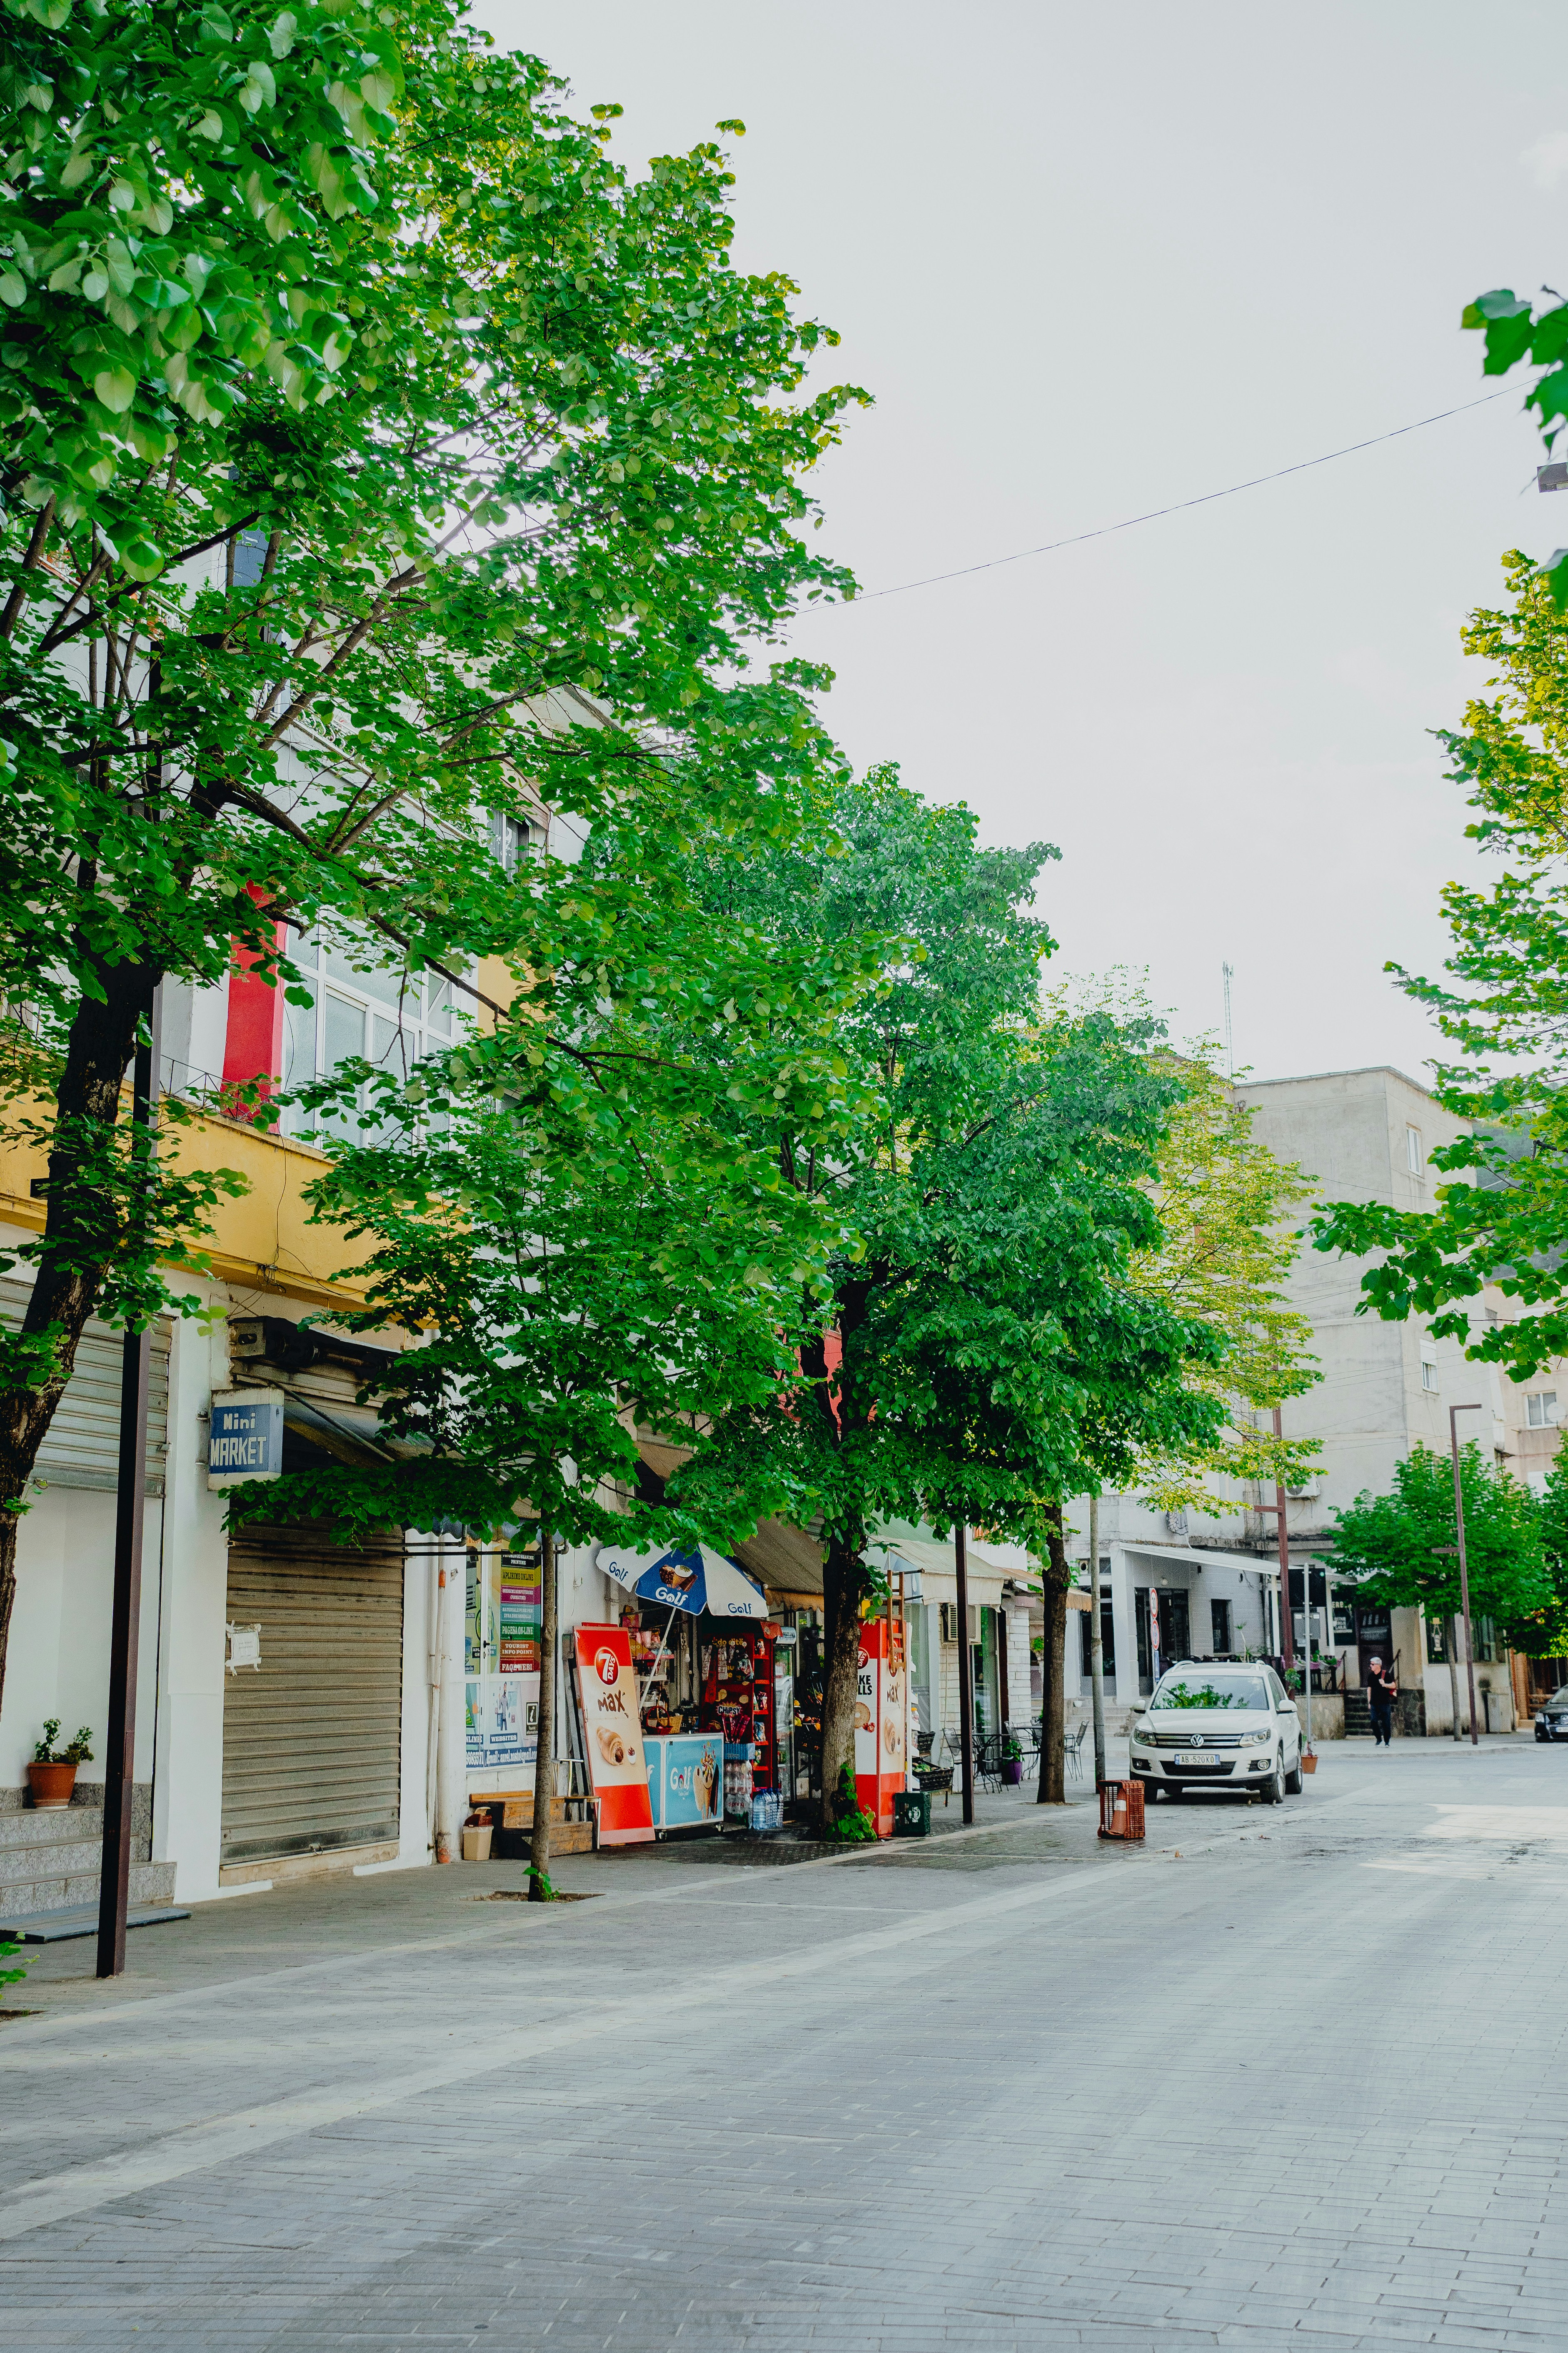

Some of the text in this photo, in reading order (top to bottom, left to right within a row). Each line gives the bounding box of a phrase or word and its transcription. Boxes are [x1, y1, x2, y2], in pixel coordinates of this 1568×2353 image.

[223, 1413, 255, 1430] Mini
[210, 1436, 267, 1466] MARKET
[609, 1562, 628, 1581] Golf
[655, 1587, 688, 1606] Golf
[728, 1603, 752, 1615] Golf
[502, 1626, 533, 1635] PAGESA ON-LINE
[599, 1653, 611, 1681] 7
[858, 1652, 867, 1666] DAYS
[670, 1766, 692, 1790] Golf
